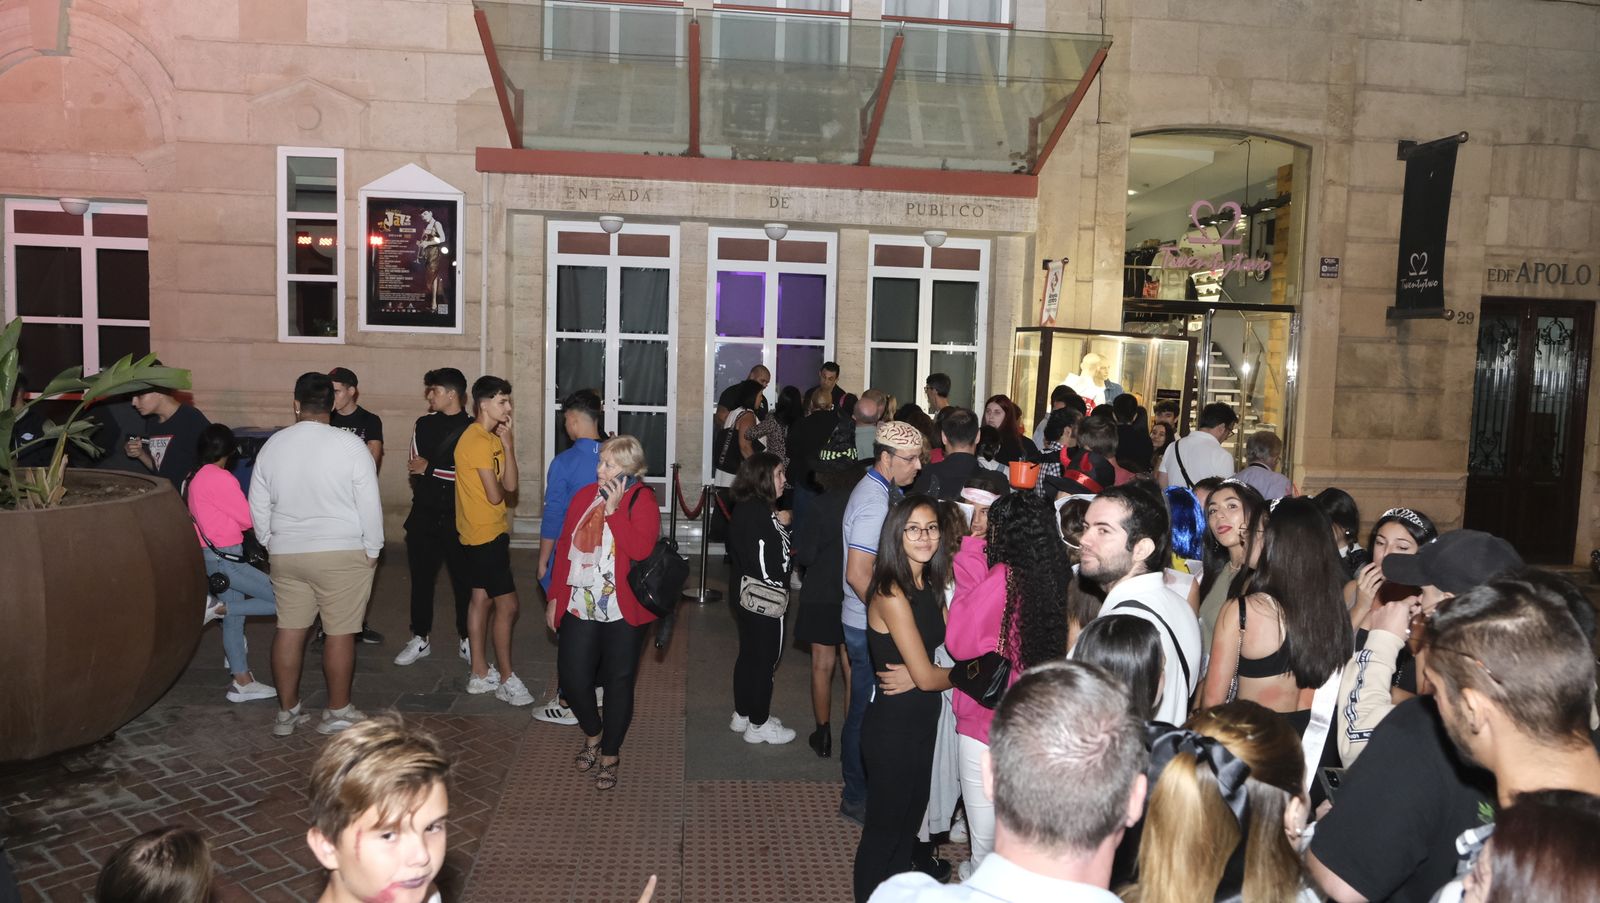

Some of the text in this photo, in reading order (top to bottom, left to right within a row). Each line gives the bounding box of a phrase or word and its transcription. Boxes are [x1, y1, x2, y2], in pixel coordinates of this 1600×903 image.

[768, 196, 790, 209] DE
[905, 202, 984, 218] PUBLICO
[1515, 262, 1592, 285] APOLO
[1456, 310, 1475, 325] 29
